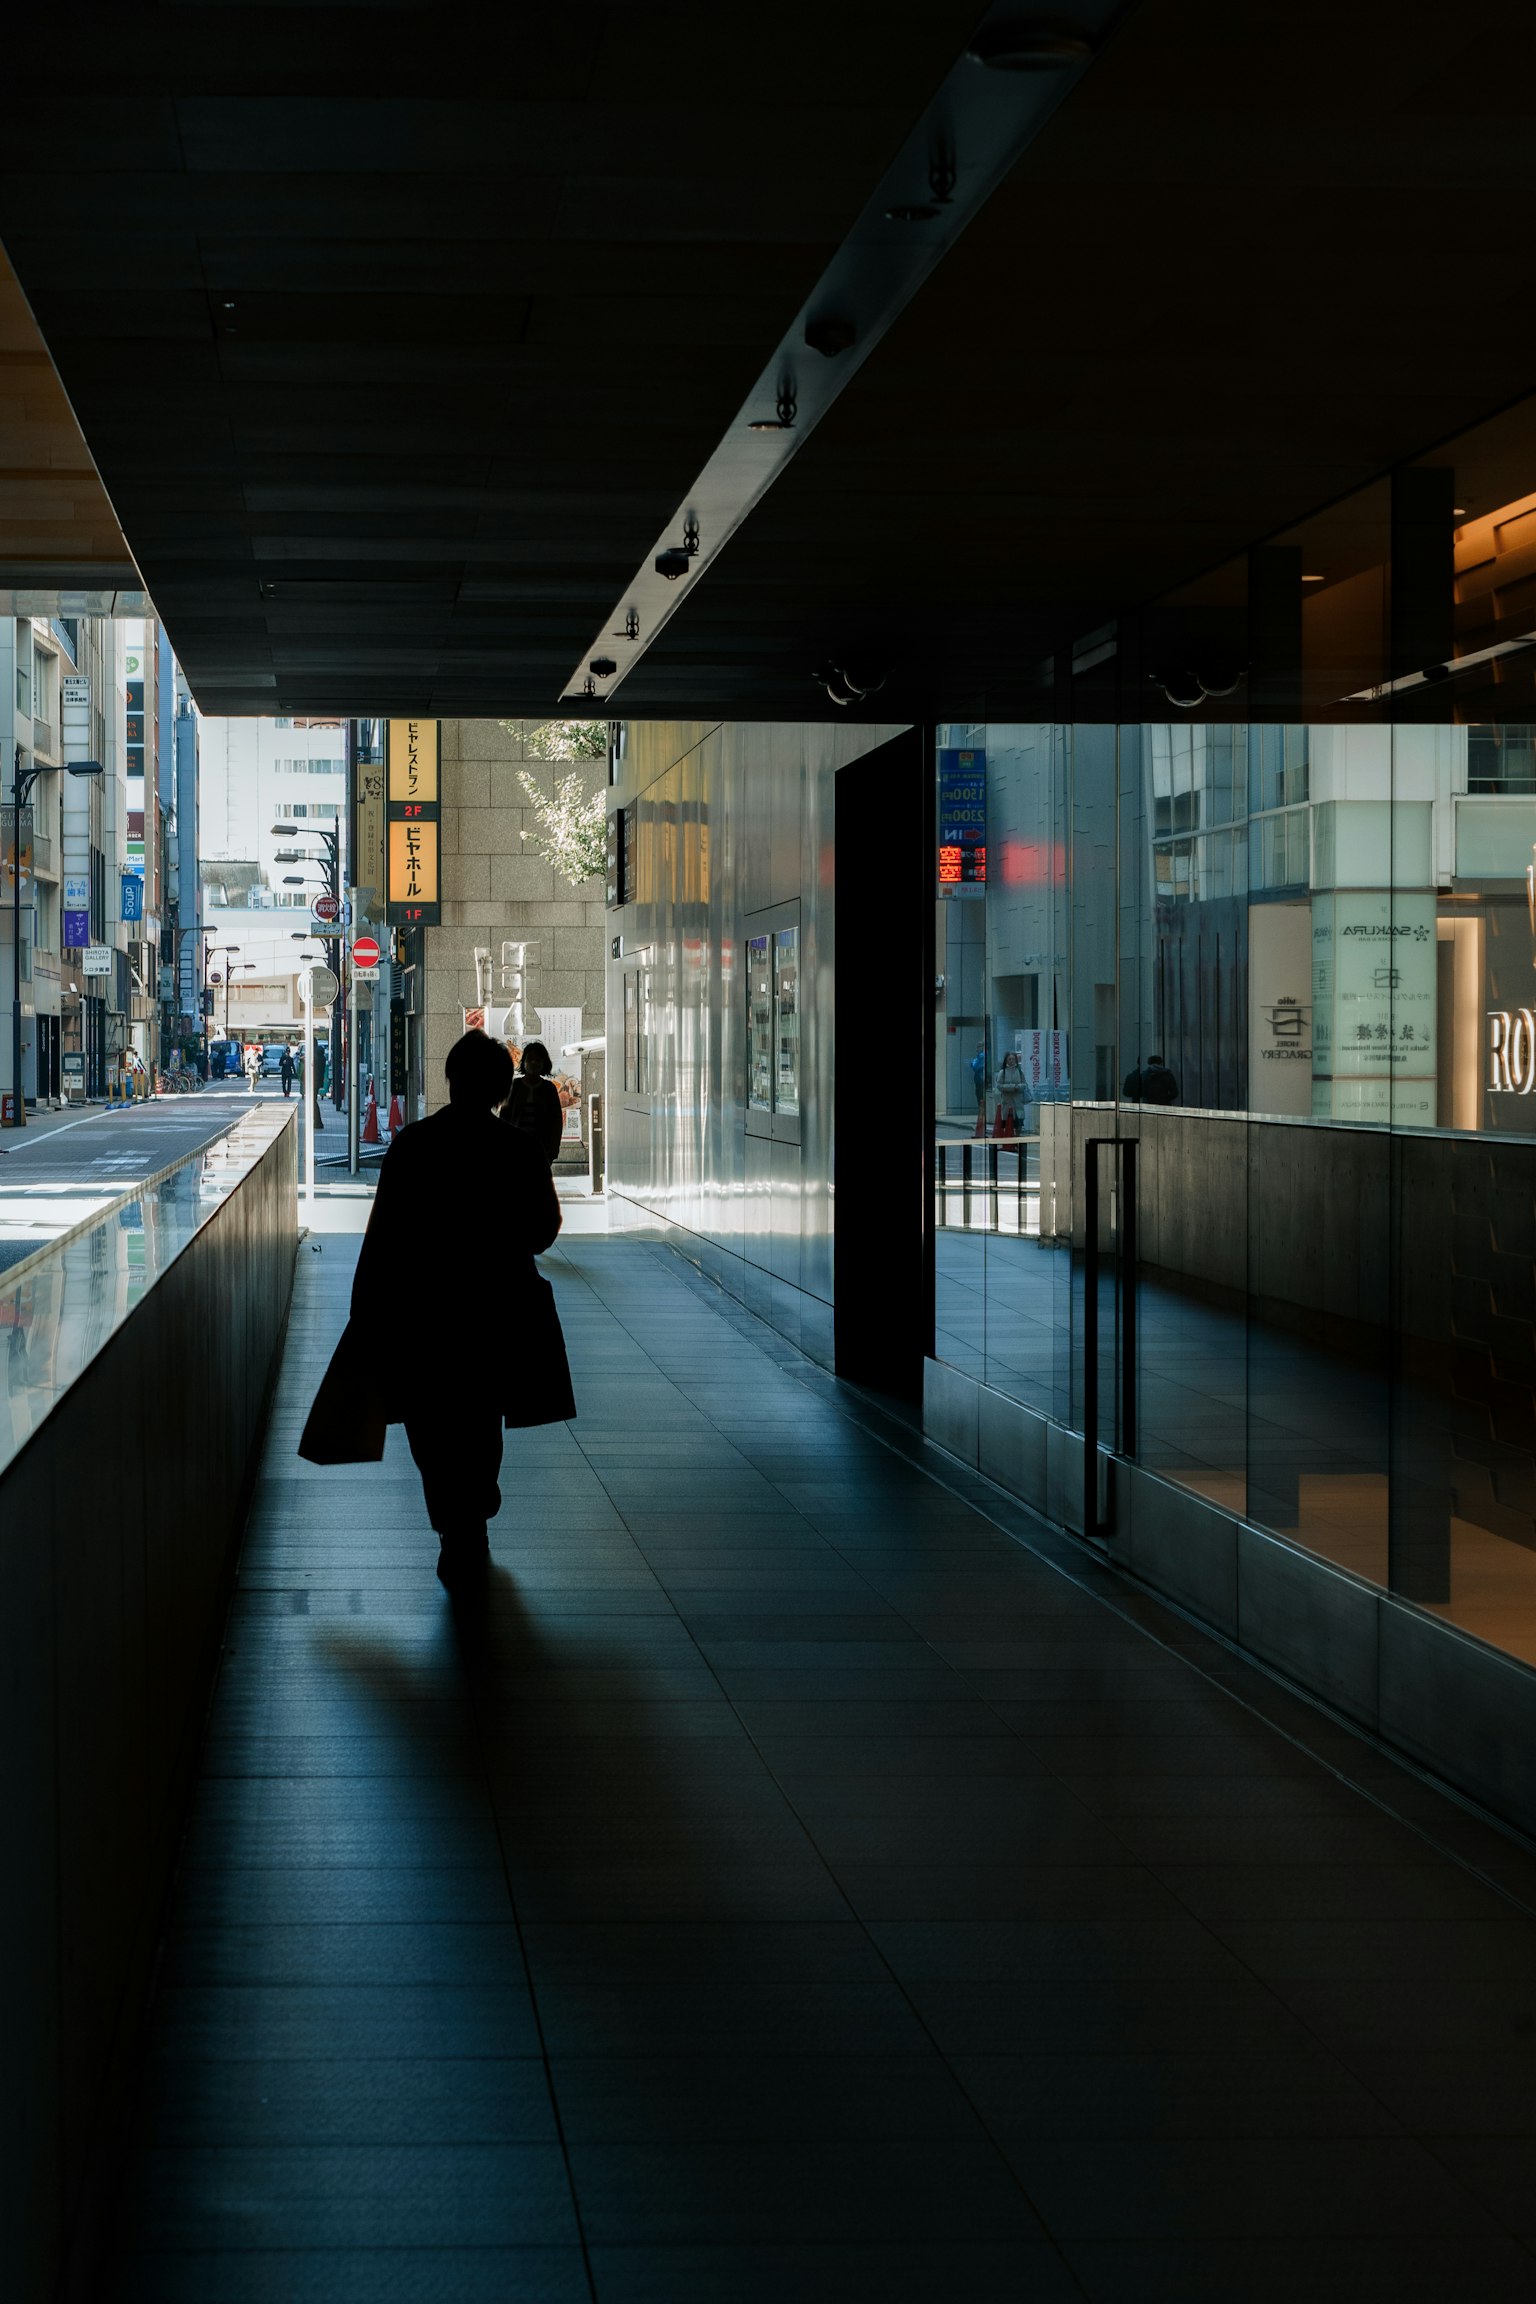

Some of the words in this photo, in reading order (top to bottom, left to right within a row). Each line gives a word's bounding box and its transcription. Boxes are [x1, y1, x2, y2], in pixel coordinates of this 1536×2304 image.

[408, 723, 418, 795] ビヤレストラン
[405, 805, 422, 817] 2F
[406, 827, 422, 896] ビヤホール
[124, 887, 135, 916] Soup
[318, 904, 337, 913] 消火栓
[406, 909, 422, 920] 1F
[1487, 1008, 1536, 1095] RO
